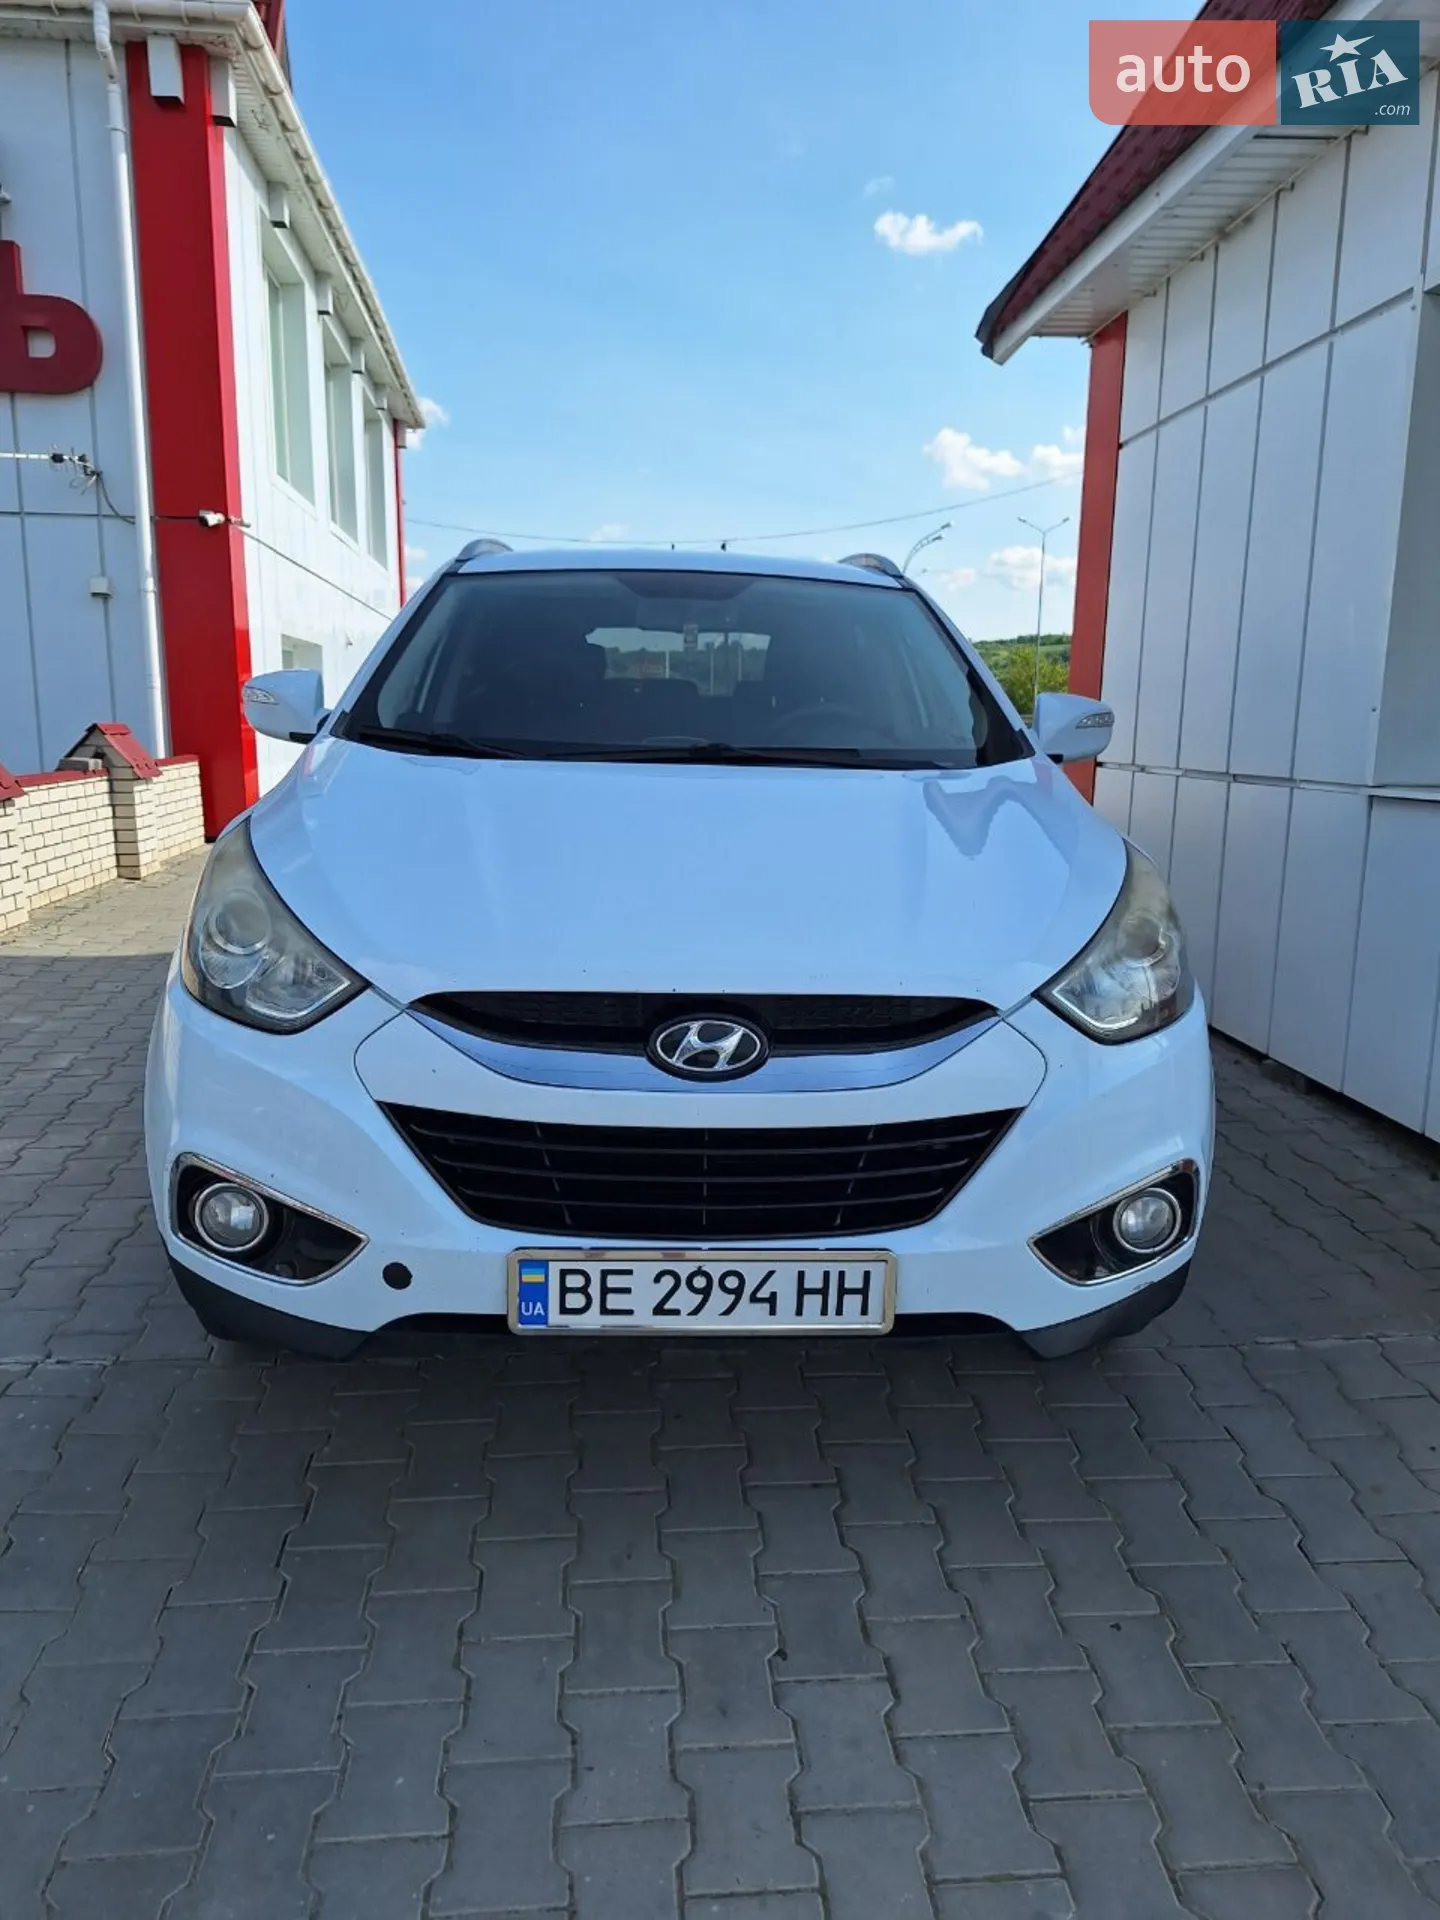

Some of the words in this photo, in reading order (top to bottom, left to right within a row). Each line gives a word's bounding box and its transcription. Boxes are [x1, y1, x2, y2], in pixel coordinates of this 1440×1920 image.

[558, 1268, 634, 1316] BE
[652, 1267, 777, 1317] 2994
[795, 1270, 871, 1317] HH
[521, 1302, 545, 1316] UA
